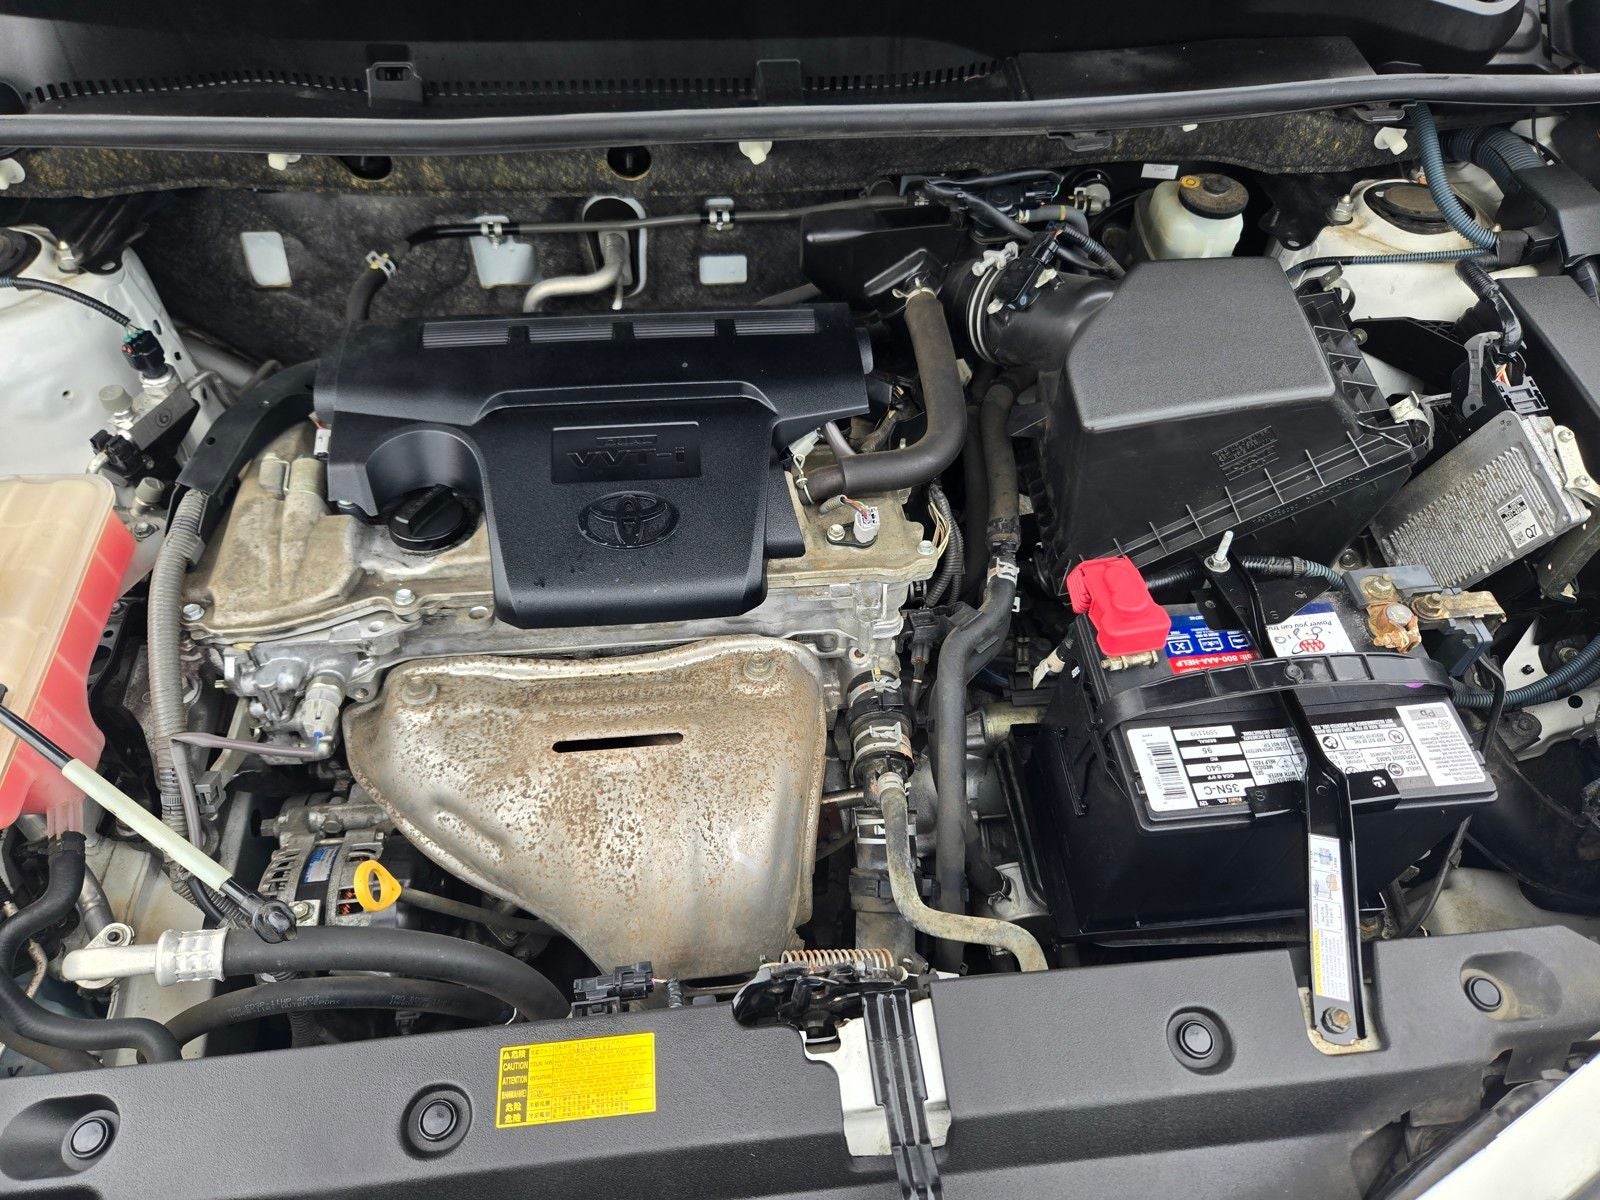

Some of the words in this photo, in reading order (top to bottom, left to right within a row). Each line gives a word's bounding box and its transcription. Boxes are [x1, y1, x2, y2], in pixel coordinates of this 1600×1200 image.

[1525, 524, 1537, 539] Q7
[1301, 640, 1323, 652] AAA
[1176, 655, 1239, 667] 800-AAA-HELP
[1205, 764, 1222, 773] 640
[1203, 783, 1240, 796] 35N-C
[502, 1061, 529, 1072] CAUTION
[502, 1075, 528, 1085] ATTENTION
